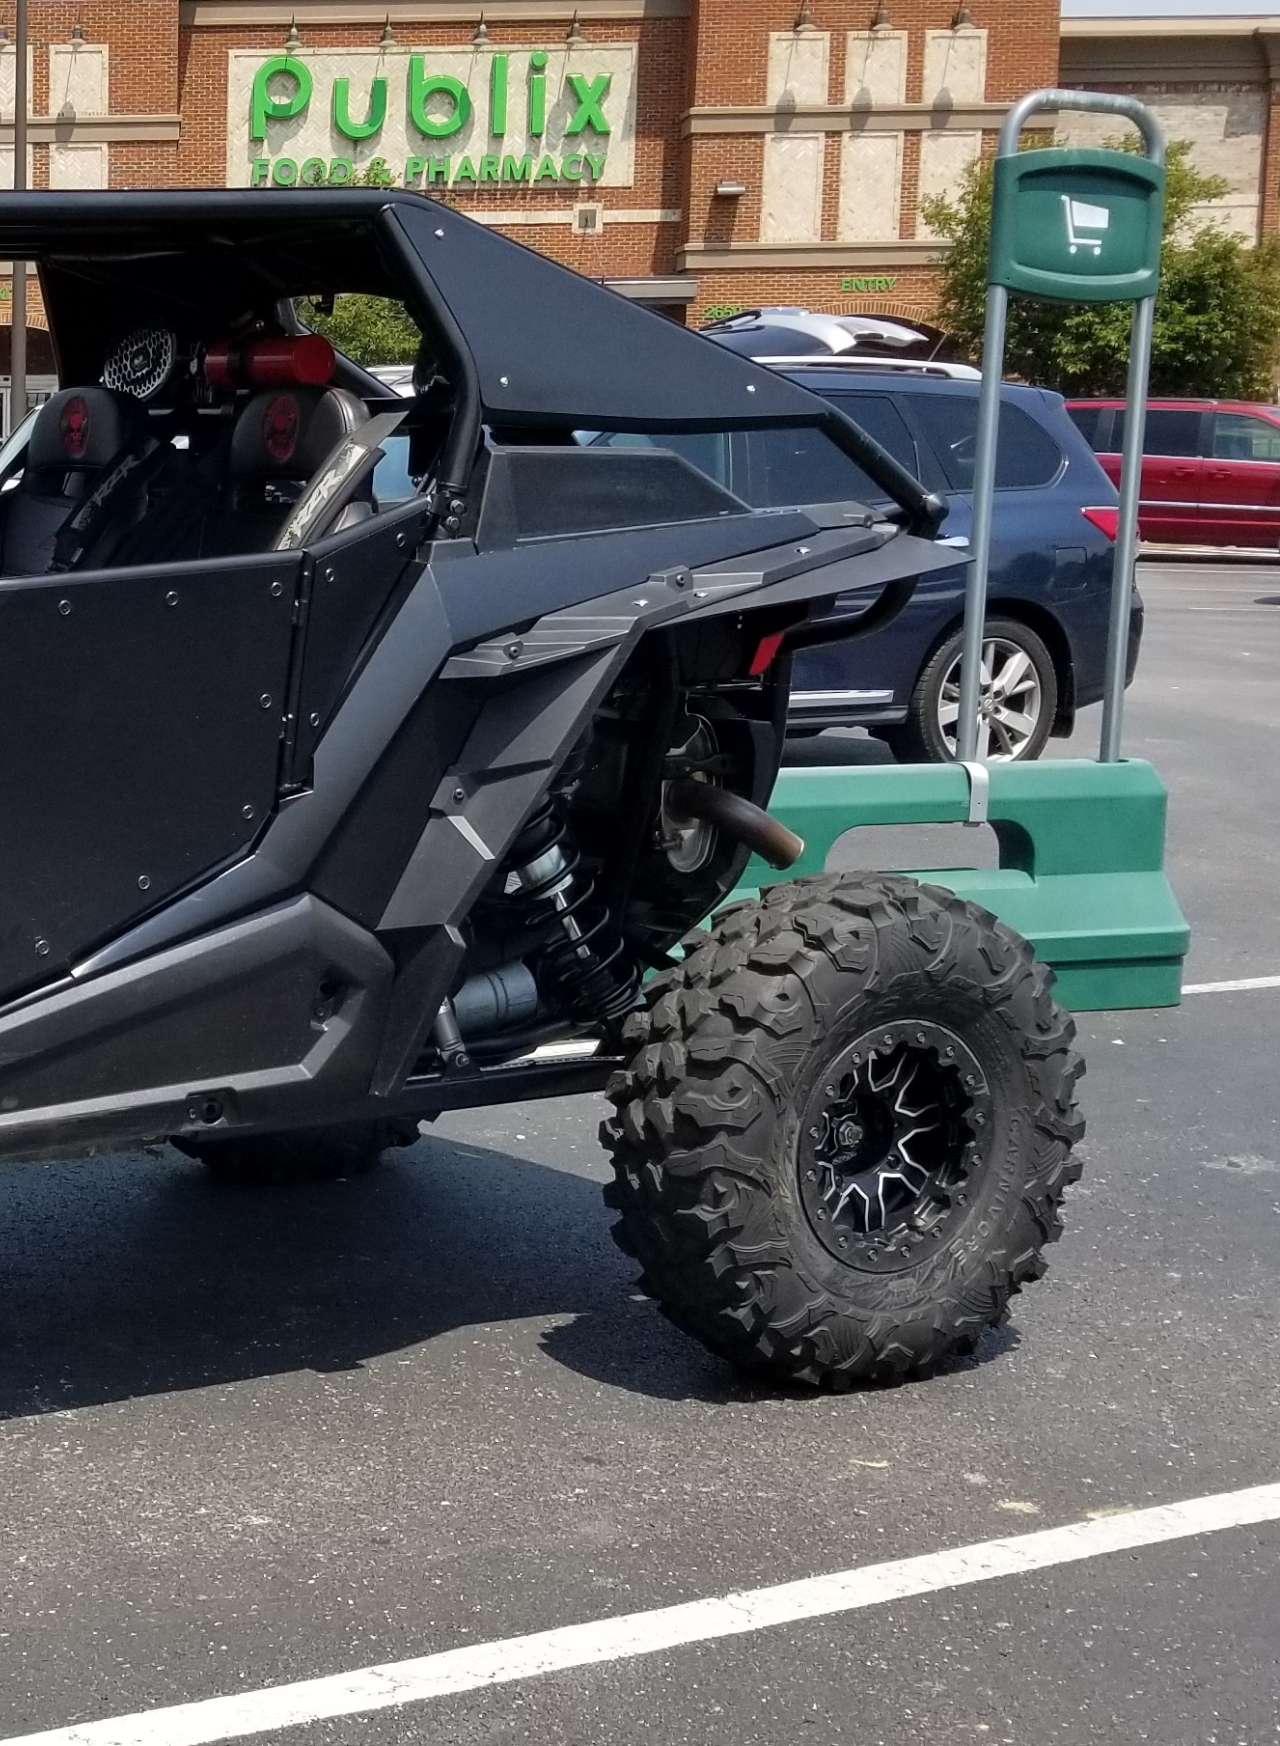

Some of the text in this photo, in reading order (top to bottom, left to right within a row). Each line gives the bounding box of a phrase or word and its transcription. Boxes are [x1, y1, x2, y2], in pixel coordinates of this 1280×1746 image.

[250, 50, 613, 141] Publix
[251, 157, 355, 186] FOOD
[407, 154, 607, 183] PHARMACY
[840, 277, 897, 292] ENTRY
